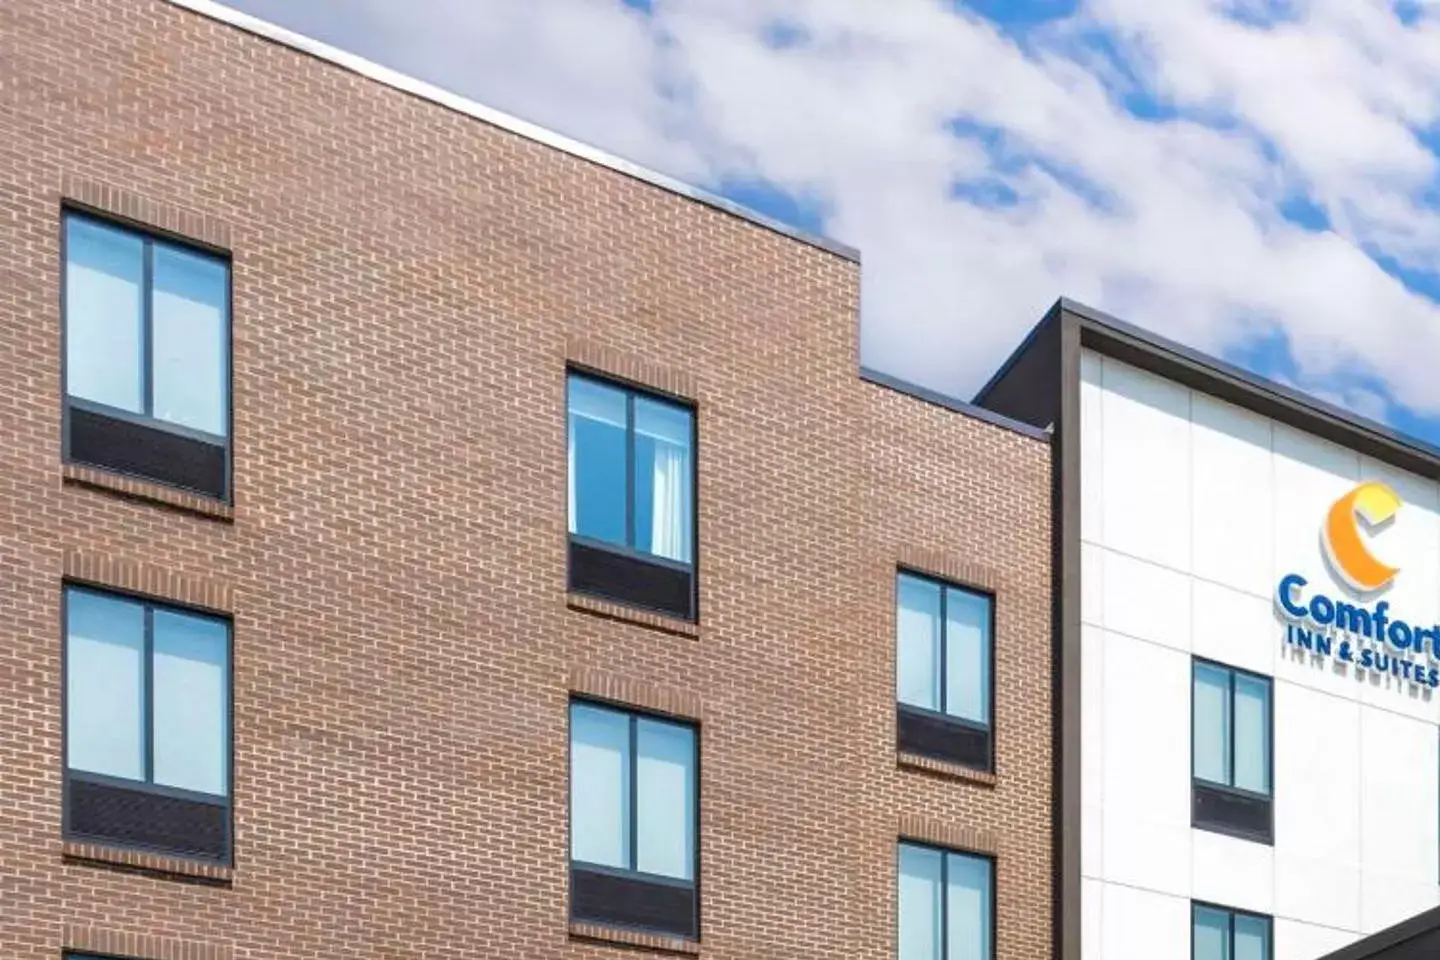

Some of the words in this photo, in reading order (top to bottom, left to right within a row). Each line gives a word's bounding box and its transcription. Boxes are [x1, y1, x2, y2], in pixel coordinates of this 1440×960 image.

[1287, 624, 1332, 656] INN
[1338, 640, 1353, 661] &
[1360, 648, 1440, 688] SUITES
